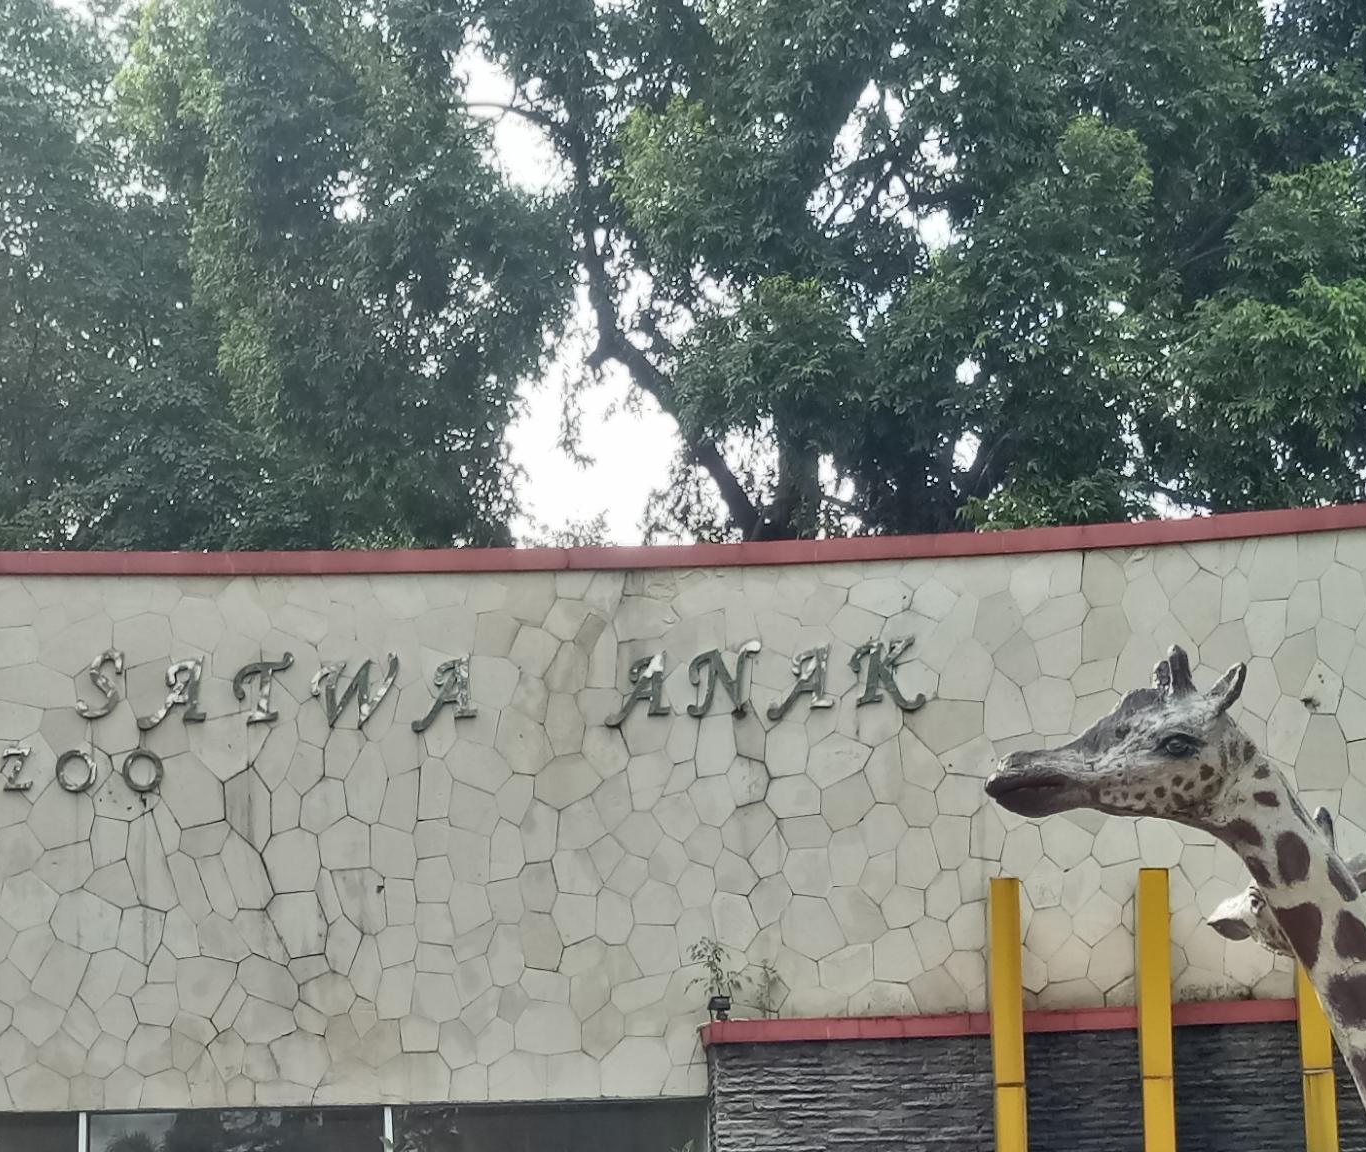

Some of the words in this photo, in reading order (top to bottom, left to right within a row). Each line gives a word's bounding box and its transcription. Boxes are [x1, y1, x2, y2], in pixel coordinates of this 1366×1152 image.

[75, 647, 478, 732] SATWA
[604, 636, 927, 728] ANAK
[1, 746, 164, 792] ZOO
